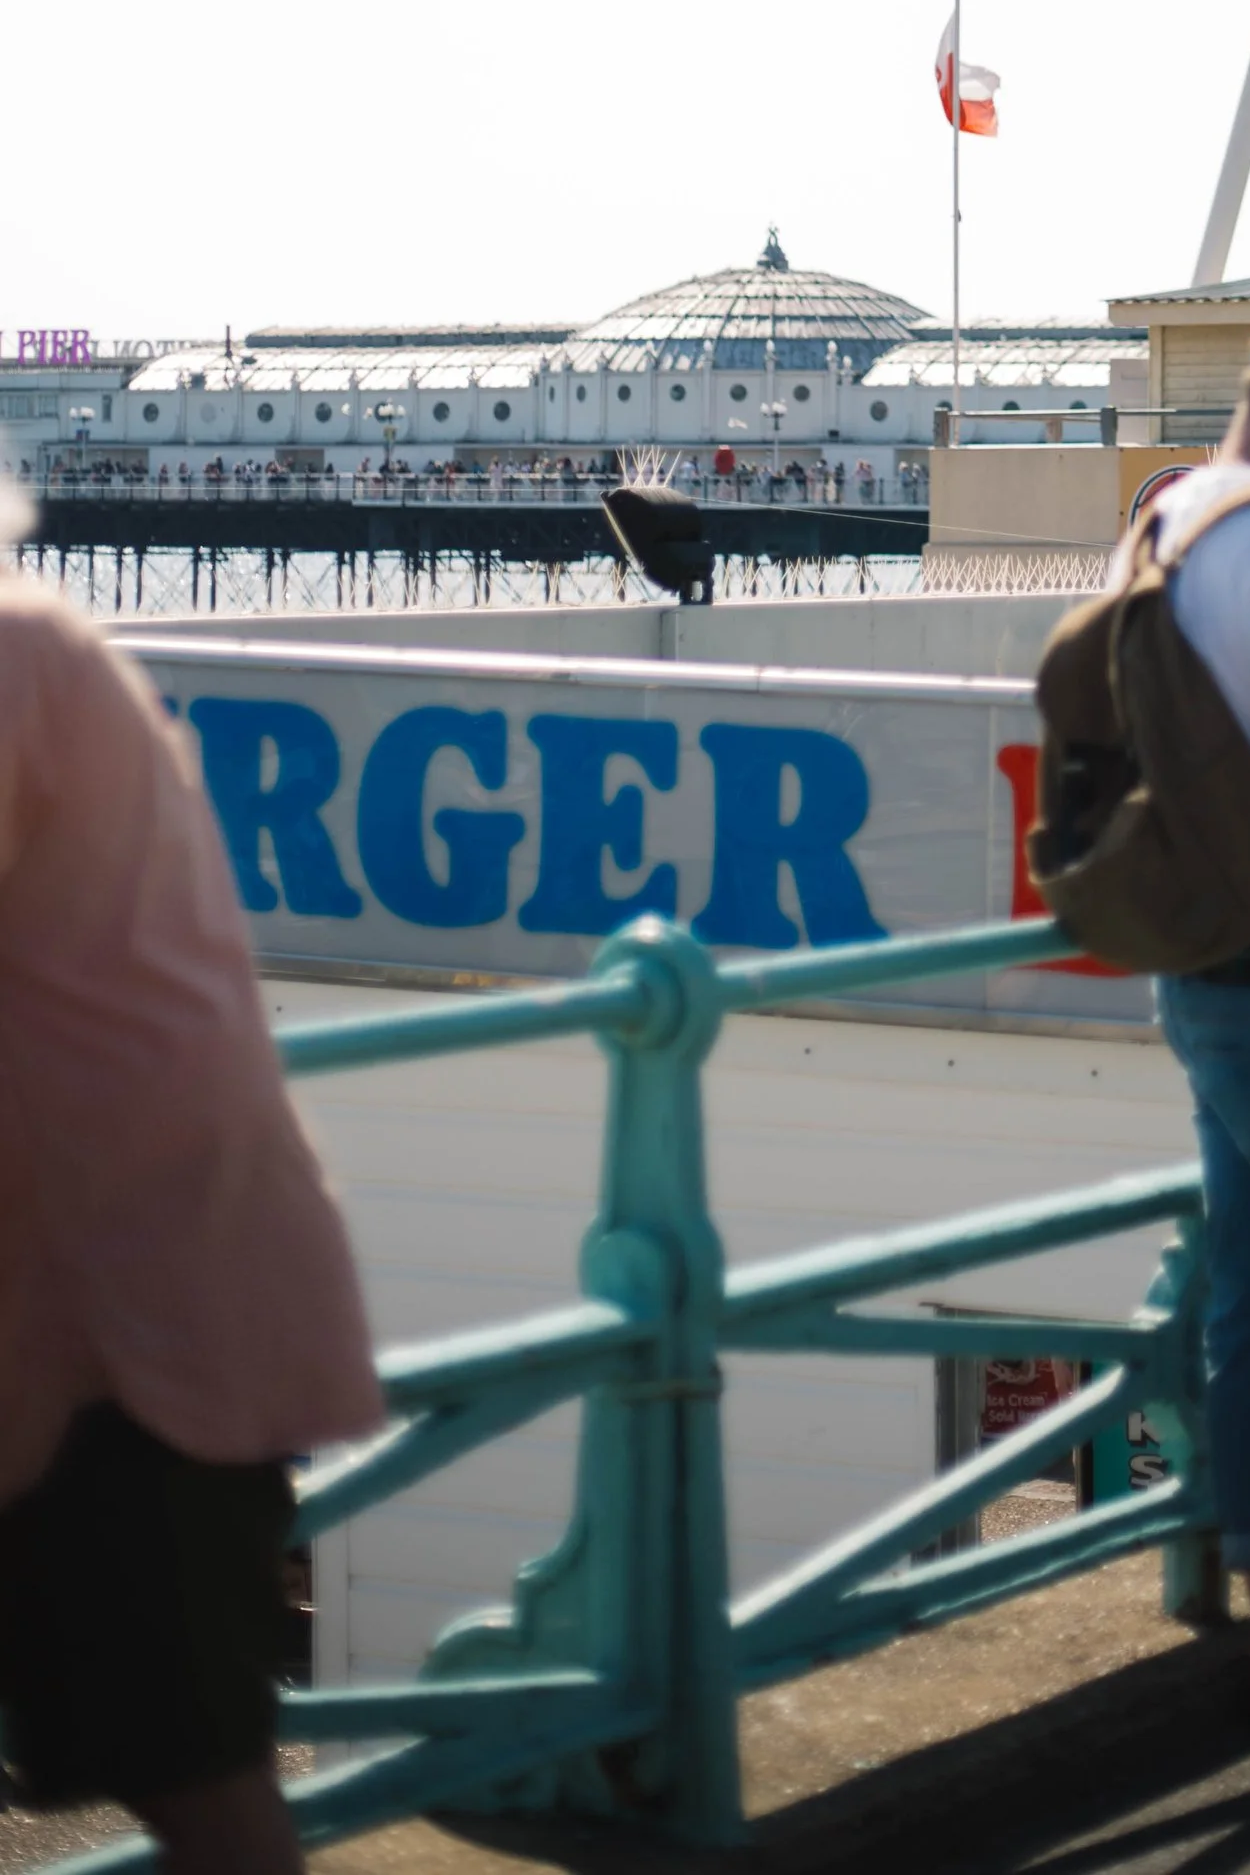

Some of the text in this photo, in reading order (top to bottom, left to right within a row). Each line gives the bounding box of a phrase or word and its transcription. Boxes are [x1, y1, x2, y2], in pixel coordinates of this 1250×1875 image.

[17, 329, 92, 365] PIER
[160, 695, 890, 950] RGER
[986, 1393, 1046, 1408] Ice Cream
[988, 1410, 1016, 1423] Sold
